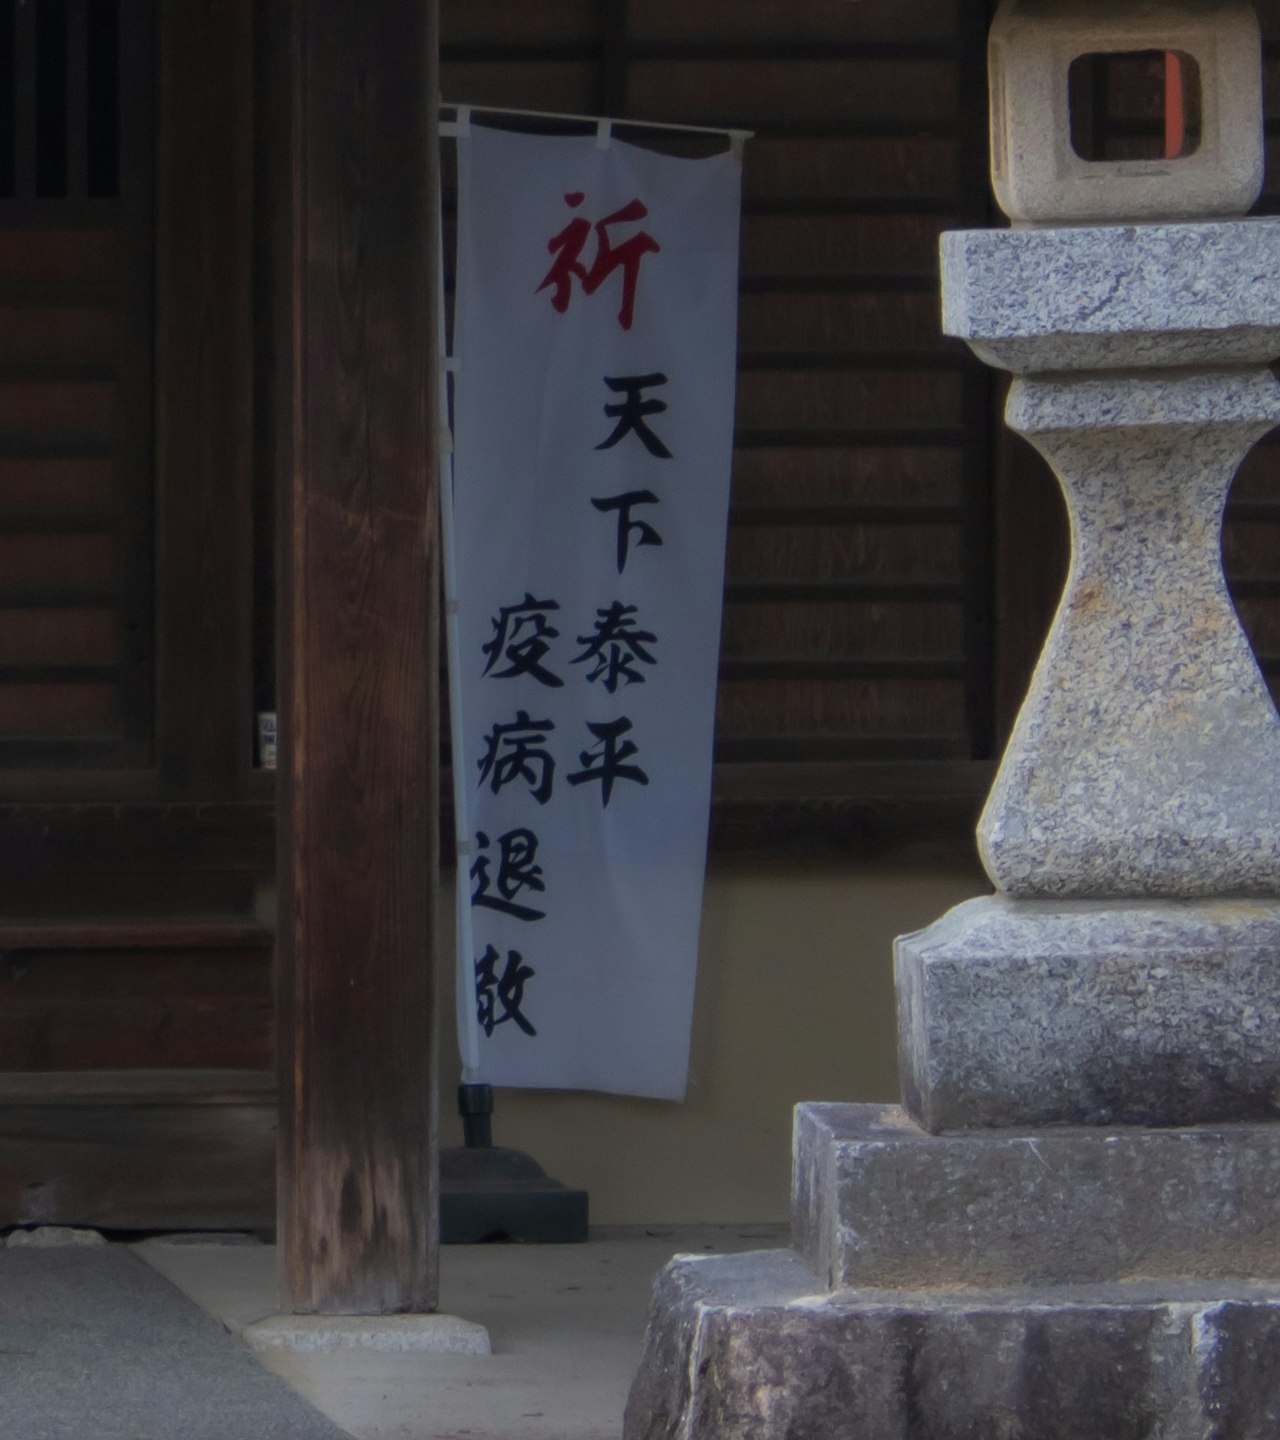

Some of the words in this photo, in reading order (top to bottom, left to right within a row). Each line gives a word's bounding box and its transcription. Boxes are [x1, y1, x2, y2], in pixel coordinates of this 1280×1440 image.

[534, 193, 661, 331] 祈
[566, 371, 675, 810] 天下泰平
[471, 592, 565, 1039] 疫病退散
